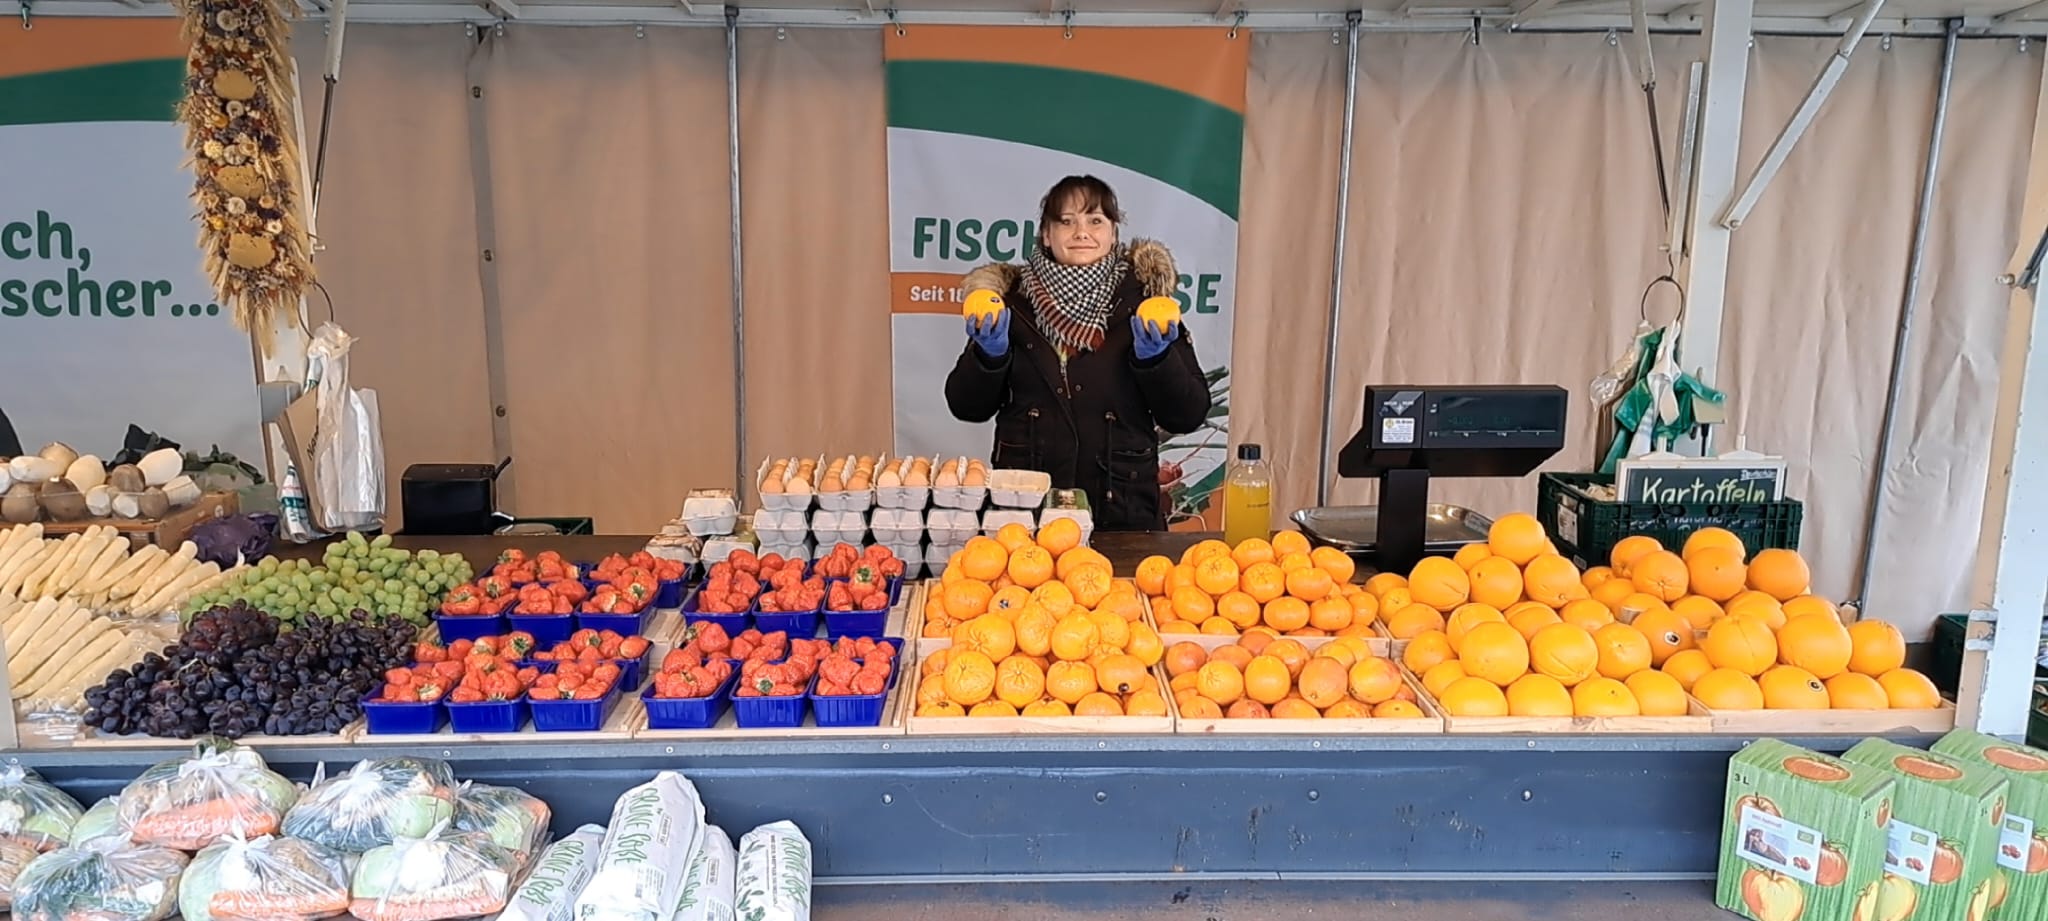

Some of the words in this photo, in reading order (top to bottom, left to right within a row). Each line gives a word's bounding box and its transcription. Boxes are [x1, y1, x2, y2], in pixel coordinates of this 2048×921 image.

[1, 209, 91, 271] ch,
[910, 285, 945, 302] Seit
[1642, 476, 1766, 504] Kartoffeln
